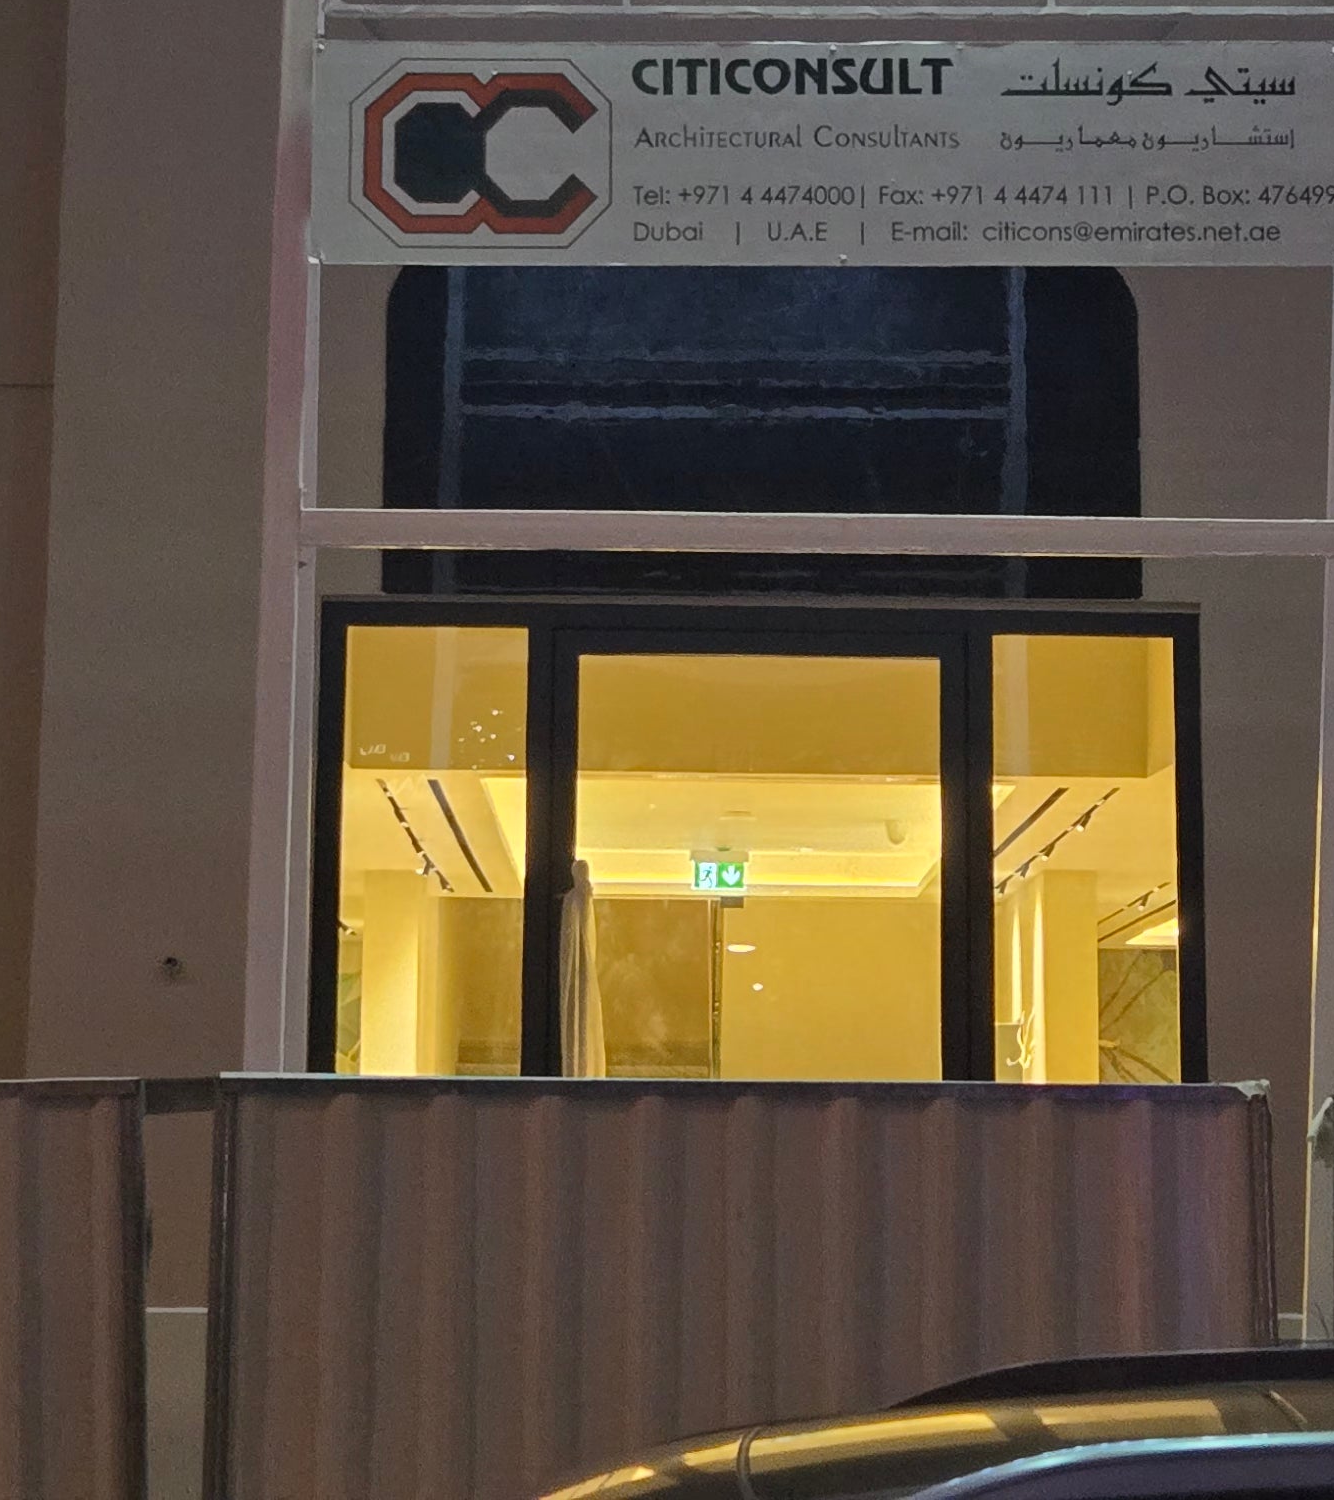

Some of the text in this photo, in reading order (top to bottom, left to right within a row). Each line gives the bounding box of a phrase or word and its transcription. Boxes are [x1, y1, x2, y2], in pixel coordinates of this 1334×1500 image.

[632, 58, 954, 95] CITICONSULT
[633, 186, 670, 205] Tel:
[678, 186, 729, 205] +971
[741, 186, 753, 205] 4
[761, 186, 855, 205] 4474000
[879, 186, 923, 205] Fax:
[932, 186, 983, 205] +971
[994, 186, 1007, 204] 4
[1015, 186, 1067, 204] 4474
[1203, 186, 1250, 205] Box:
[633, 222, 703, 241] Dubai
[768, 222, 827, 241] U.A.E
[892, 222, 967, 241] E-mail:
[983, 221, 1281, 242] citicons@emirates.net.ae
